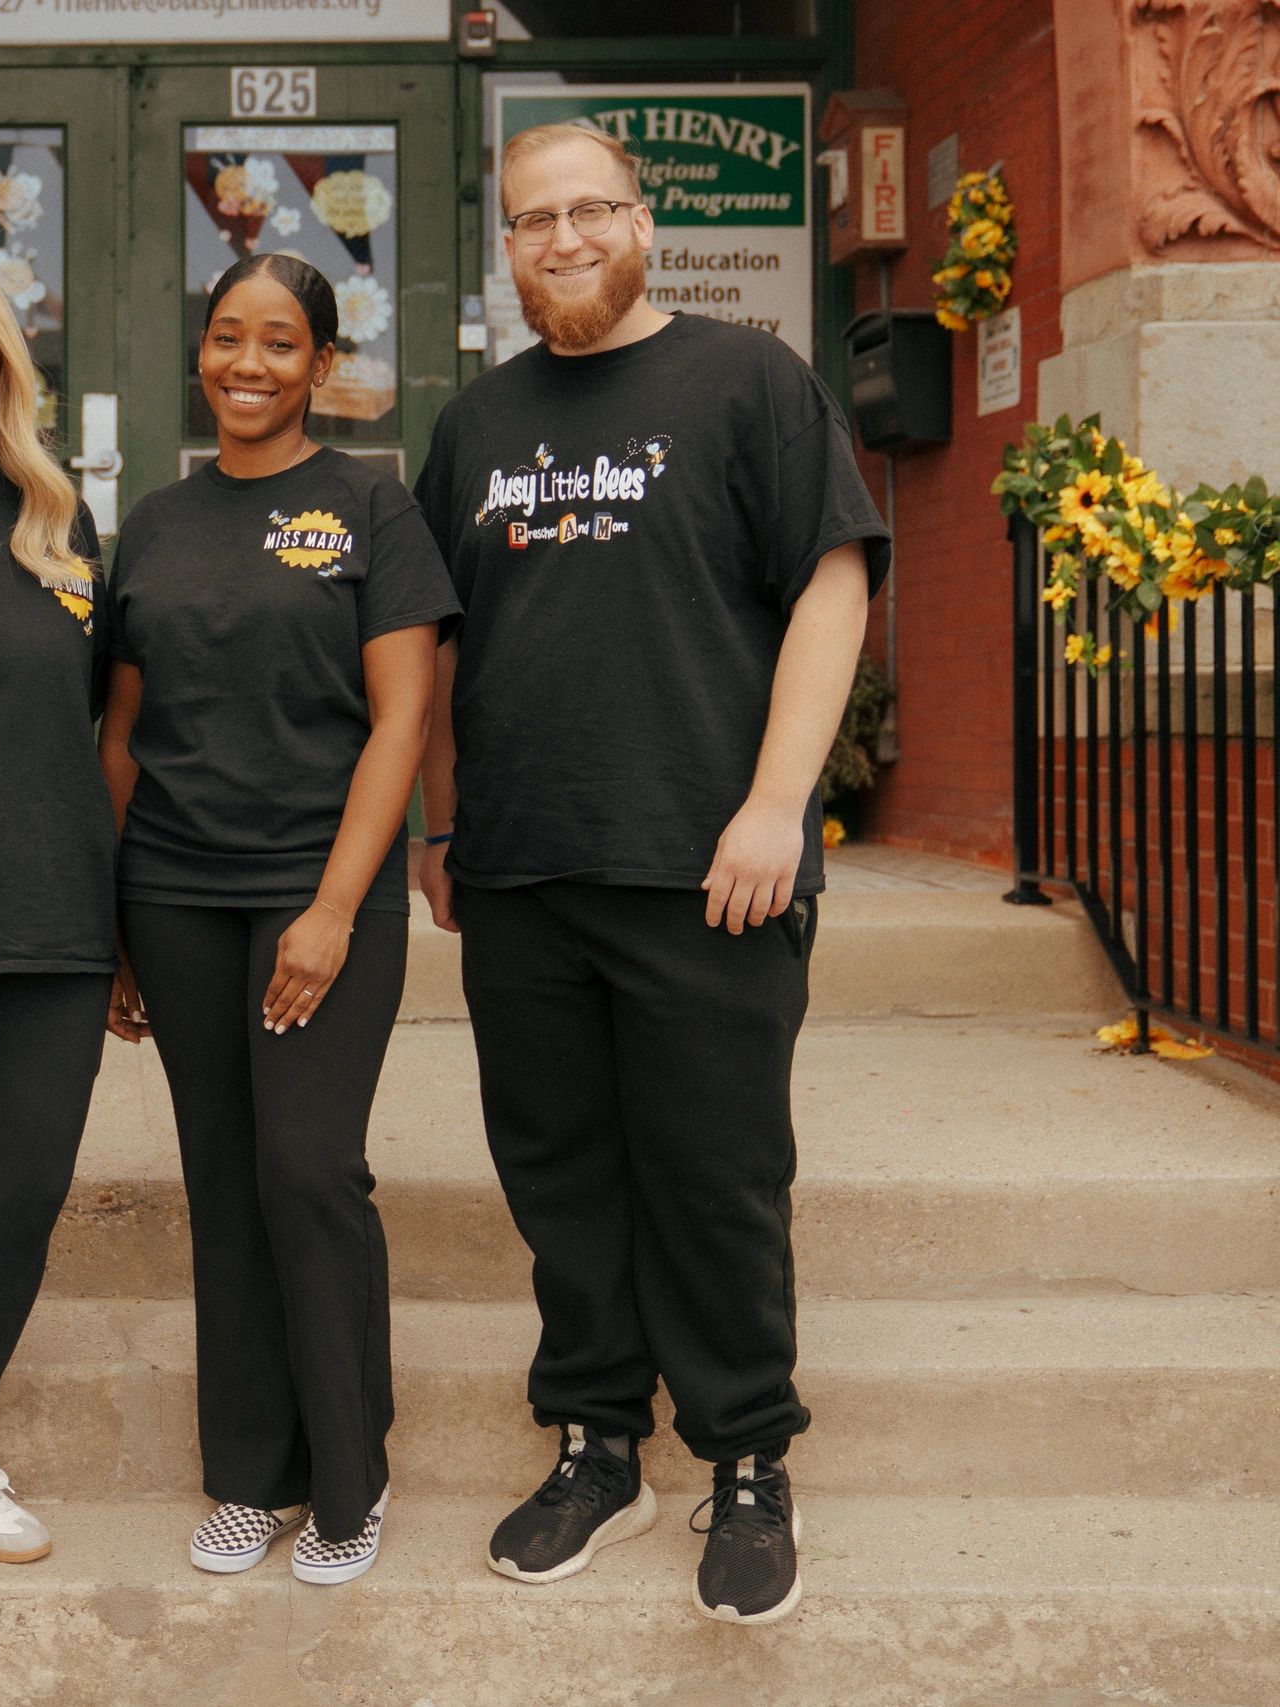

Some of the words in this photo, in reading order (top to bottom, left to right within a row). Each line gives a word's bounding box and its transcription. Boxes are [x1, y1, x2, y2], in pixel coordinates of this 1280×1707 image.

[237, 71, 311, 113] 625
[642, 107, 800, 170] HENRY
[874, 133, 897, 233] FIRE
[662, 186, 793, 217] Programs
[660, 248, 781, 271] Education
[646, 280, 741, 304] rmation
[488, 468, 536, 517] Busy
[539, 465, 590, 503] Little
[592, 455, 646, 502] Bees
[263, 530, 301, 550] MISS
[304, 531, 353, 554] MARIA
[563, 519, 590, 541] And
[596, 518, 629, 539] More
